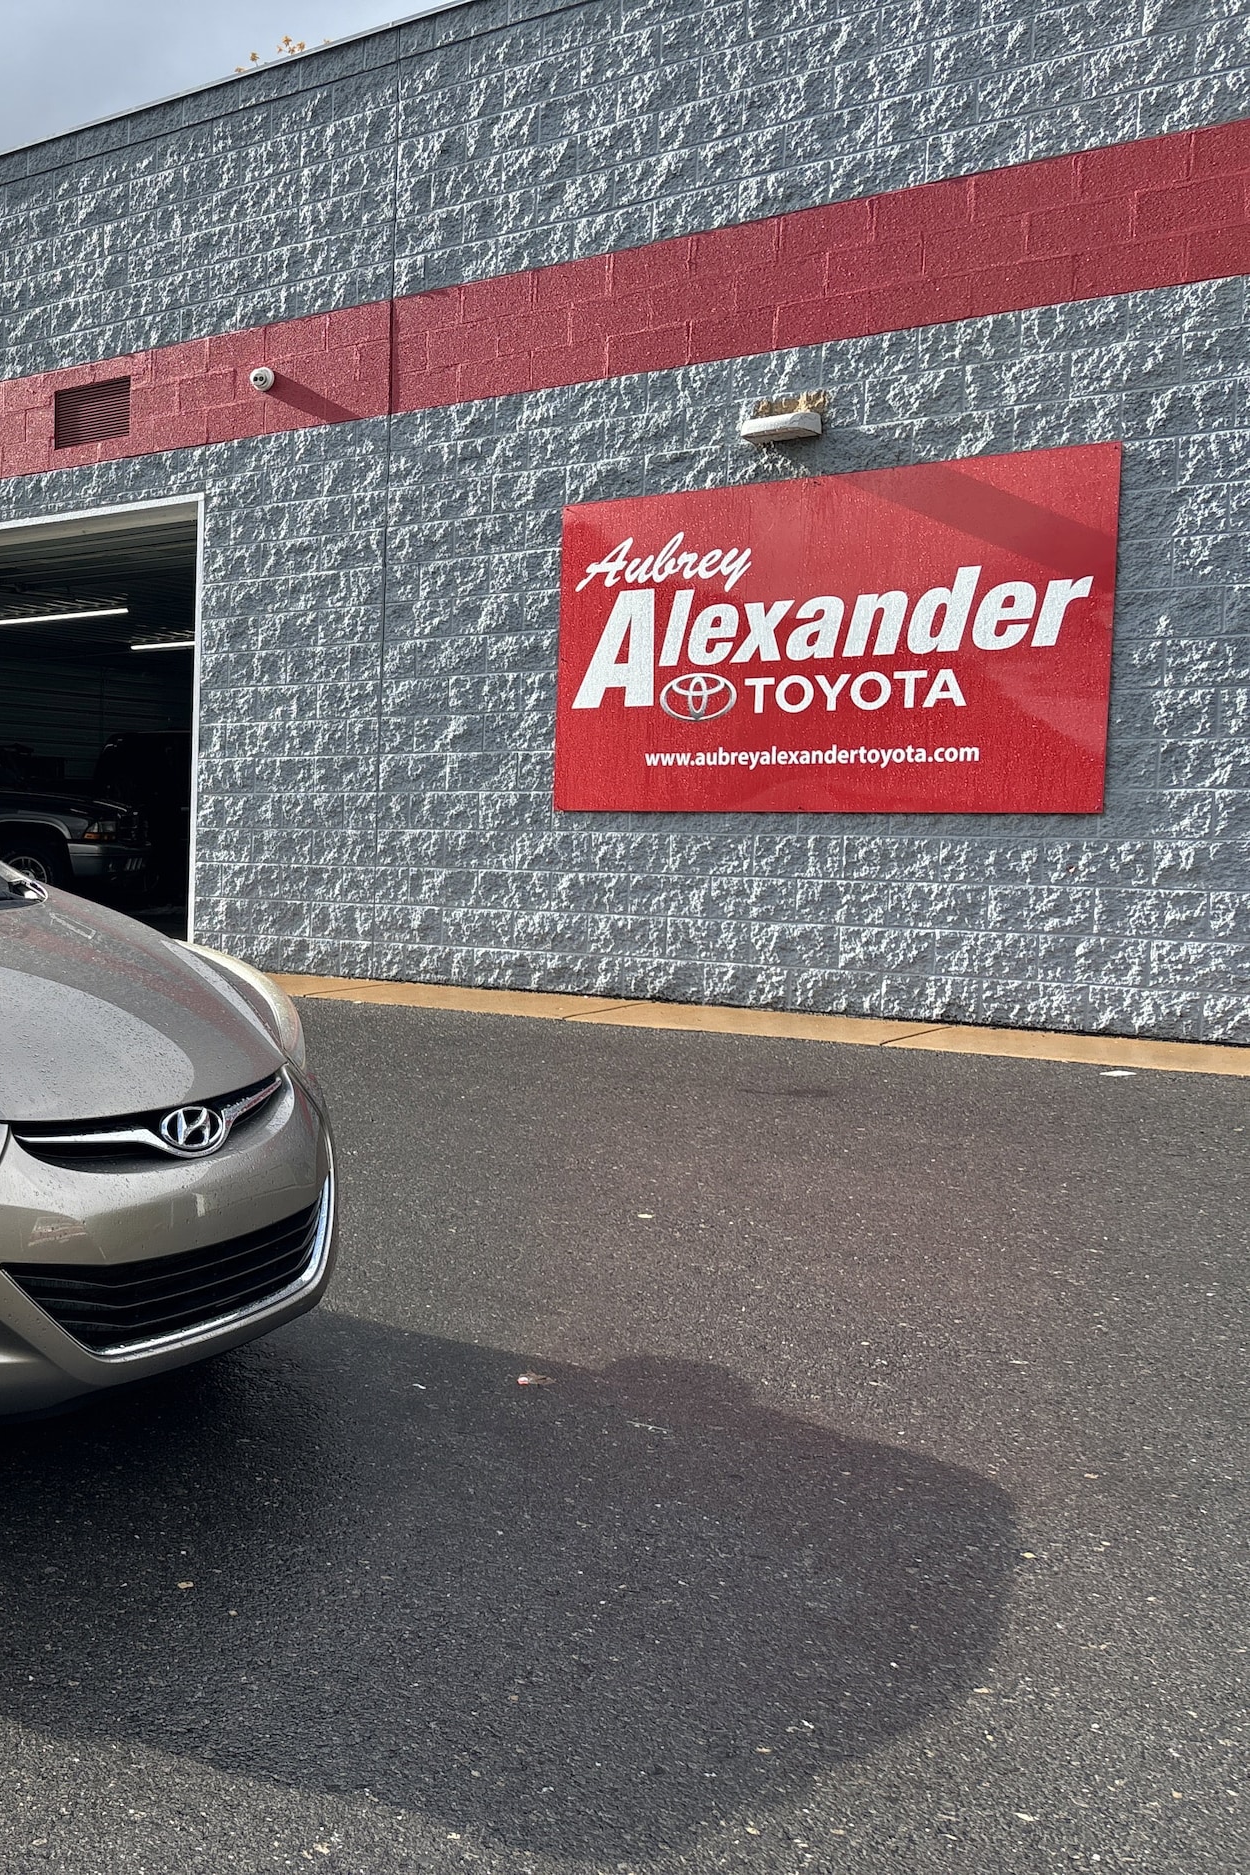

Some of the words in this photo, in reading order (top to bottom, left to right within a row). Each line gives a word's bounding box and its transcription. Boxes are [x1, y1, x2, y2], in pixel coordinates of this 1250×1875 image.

[575, 531, 752, 593] Aubrey
[572, 565, 1095, 710] Alexander
[744, 668, 967, 713] TOYOTA
[644, 744, 980, 770] www.aubreyalexandertoyota.com
